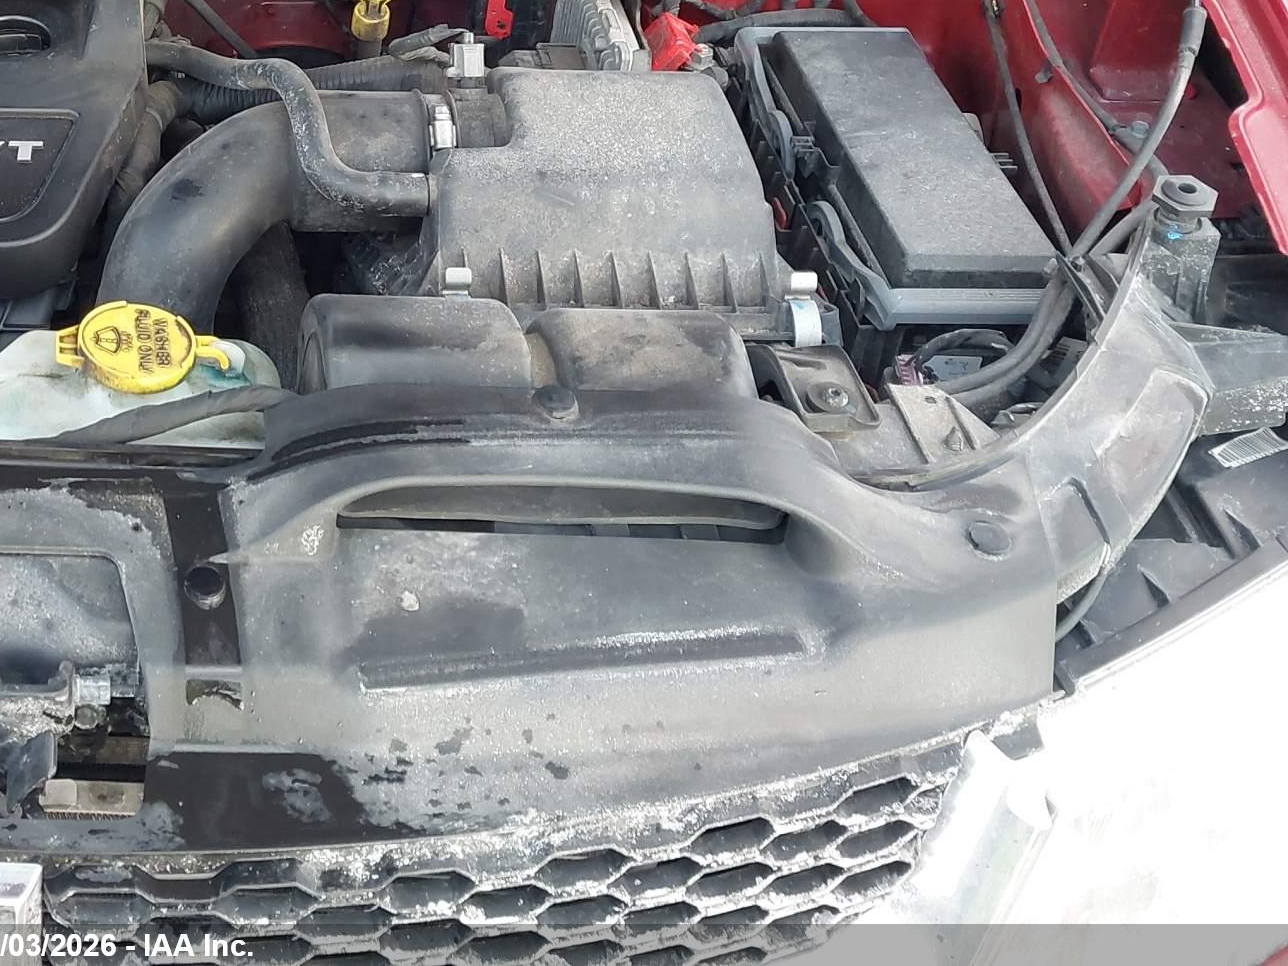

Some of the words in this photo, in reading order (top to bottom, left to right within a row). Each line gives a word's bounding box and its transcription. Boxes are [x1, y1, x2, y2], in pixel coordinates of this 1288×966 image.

[135, 308, 152, 343] FLUID
[153, 318, 172, 368] WASHER
[138, 345, 154, 374] ONLY
